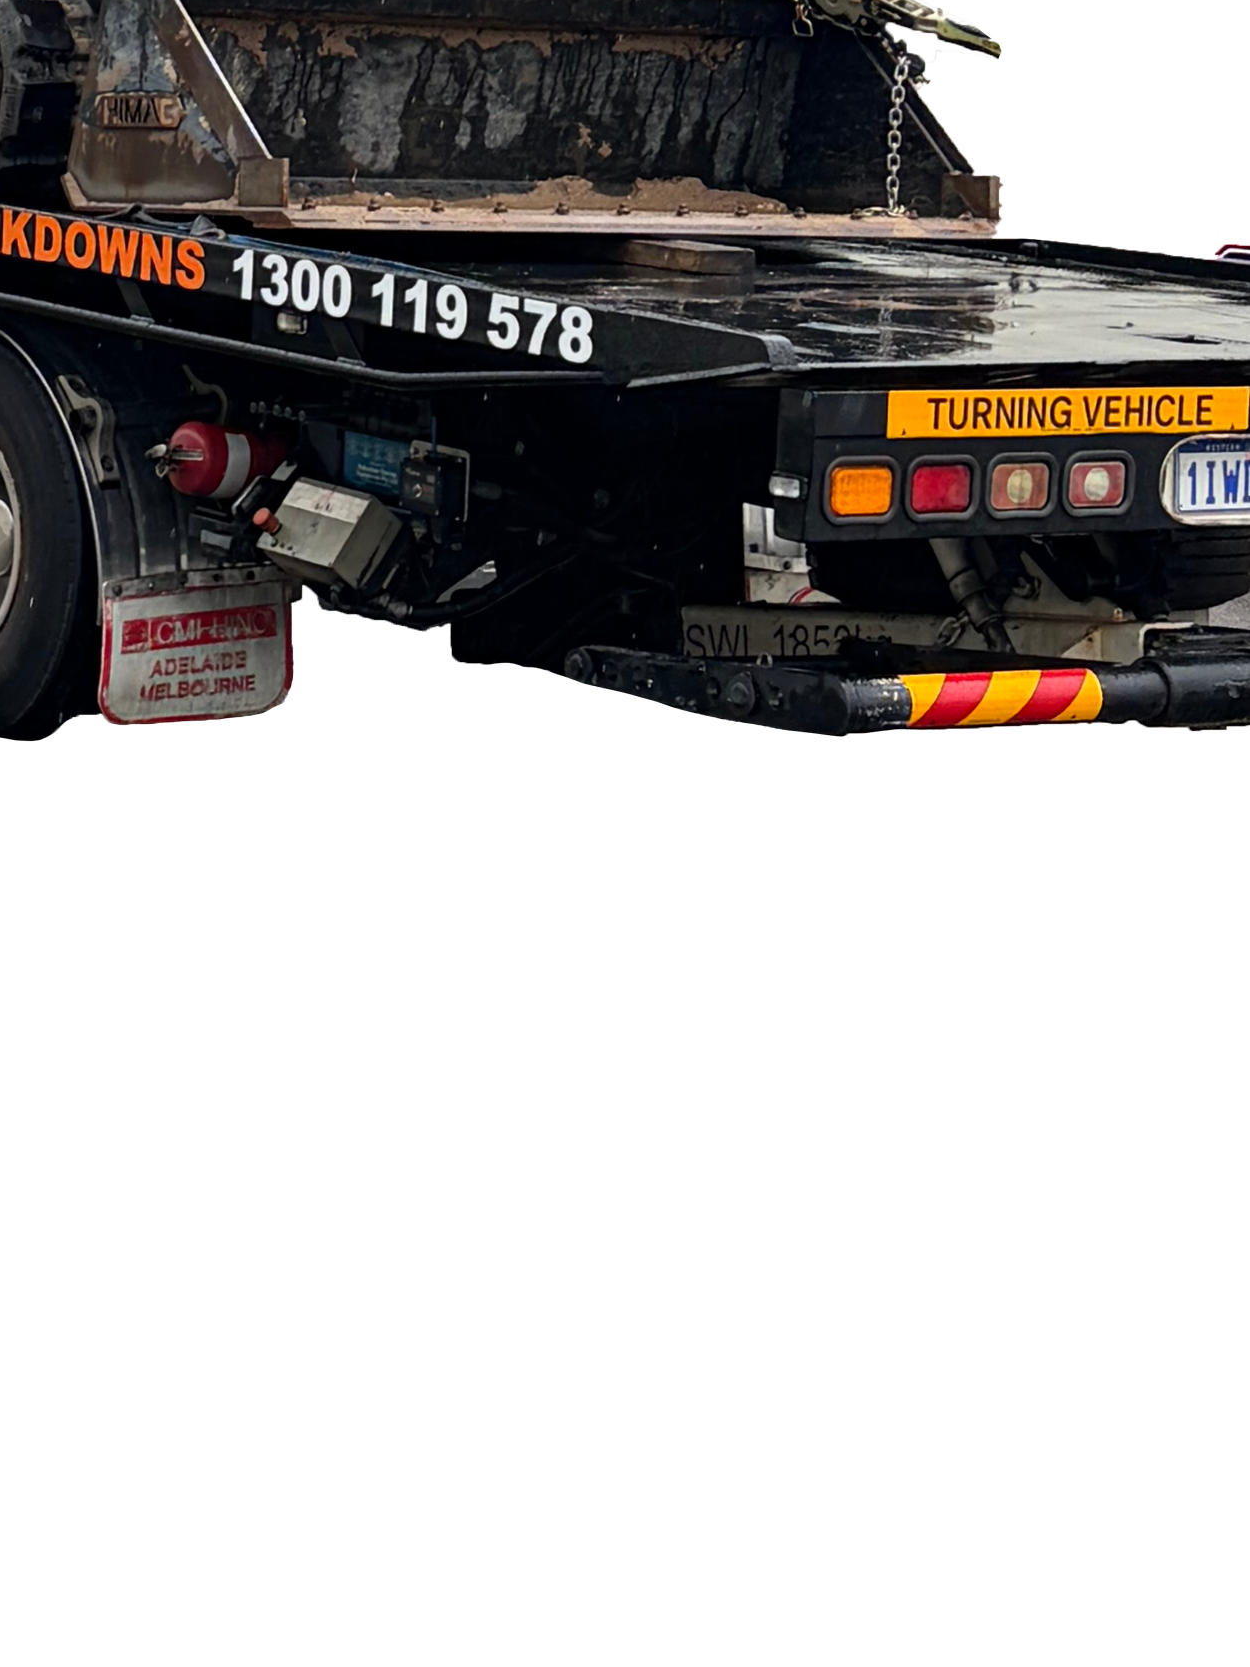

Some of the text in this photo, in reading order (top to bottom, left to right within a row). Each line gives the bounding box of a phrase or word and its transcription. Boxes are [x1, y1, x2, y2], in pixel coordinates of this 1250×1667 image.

[232, 249, 352, 319] 1300
[371, 274, 468, 340] 119
[487, 299, 594, 365] 578
[927, 394, 1214, 430] TURNING VEHICLE
[149, 651, 247, 679] ADELAIDE
[139, 675, 256, 702] MELBOURNE
